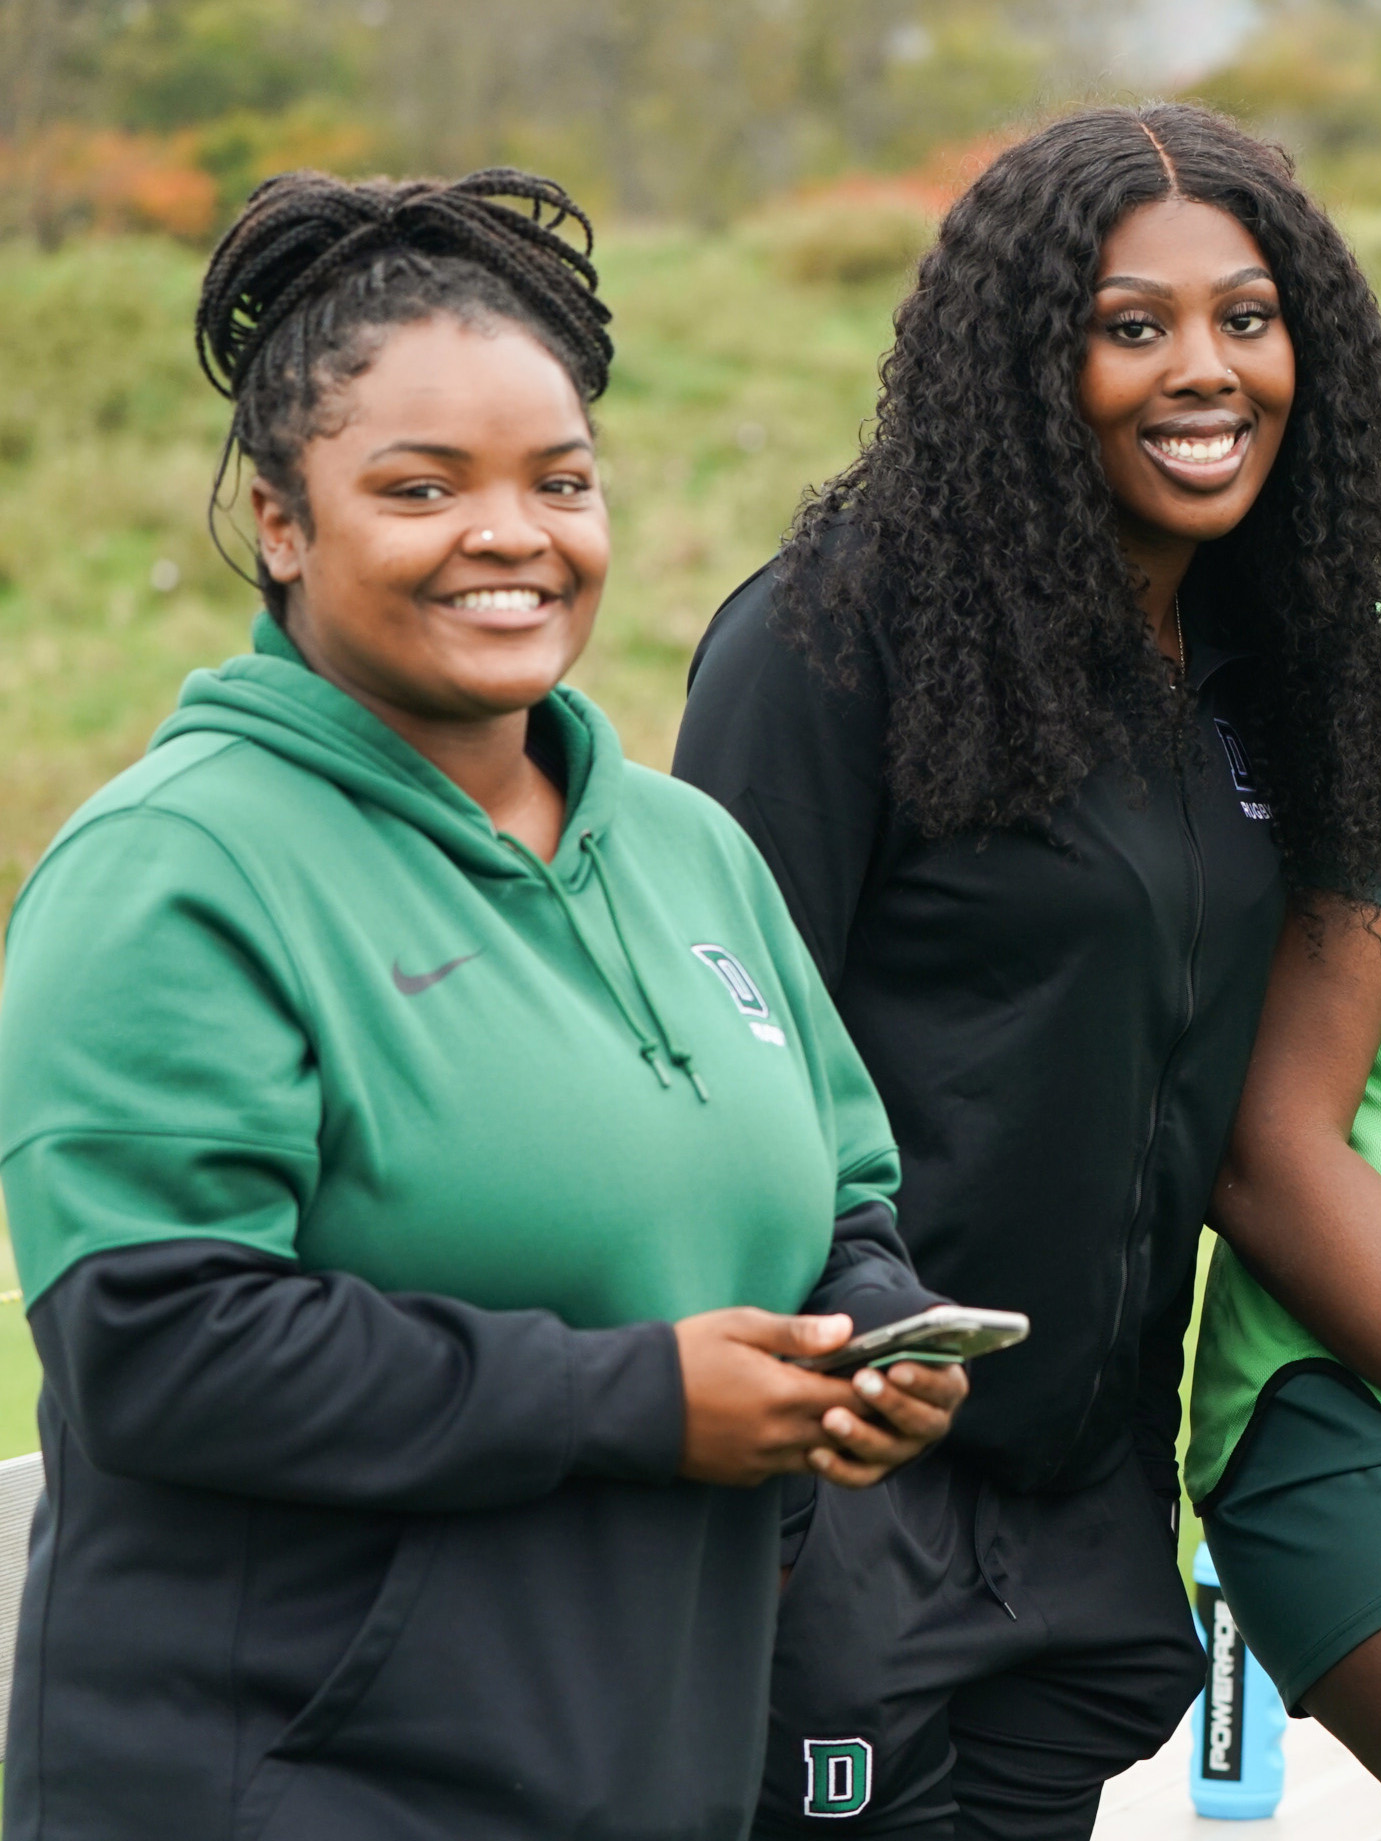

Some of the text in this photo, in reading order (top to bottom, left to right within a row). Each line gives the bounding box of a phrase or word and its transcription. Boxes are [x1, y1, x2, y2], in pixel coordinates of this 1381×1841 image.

[1214, 718, 1256, 792] D
[1240, 801, 1273, 820] RUGBY
[690, 944, 768, 1018] D
[804, 1737, 872, 1818] D
